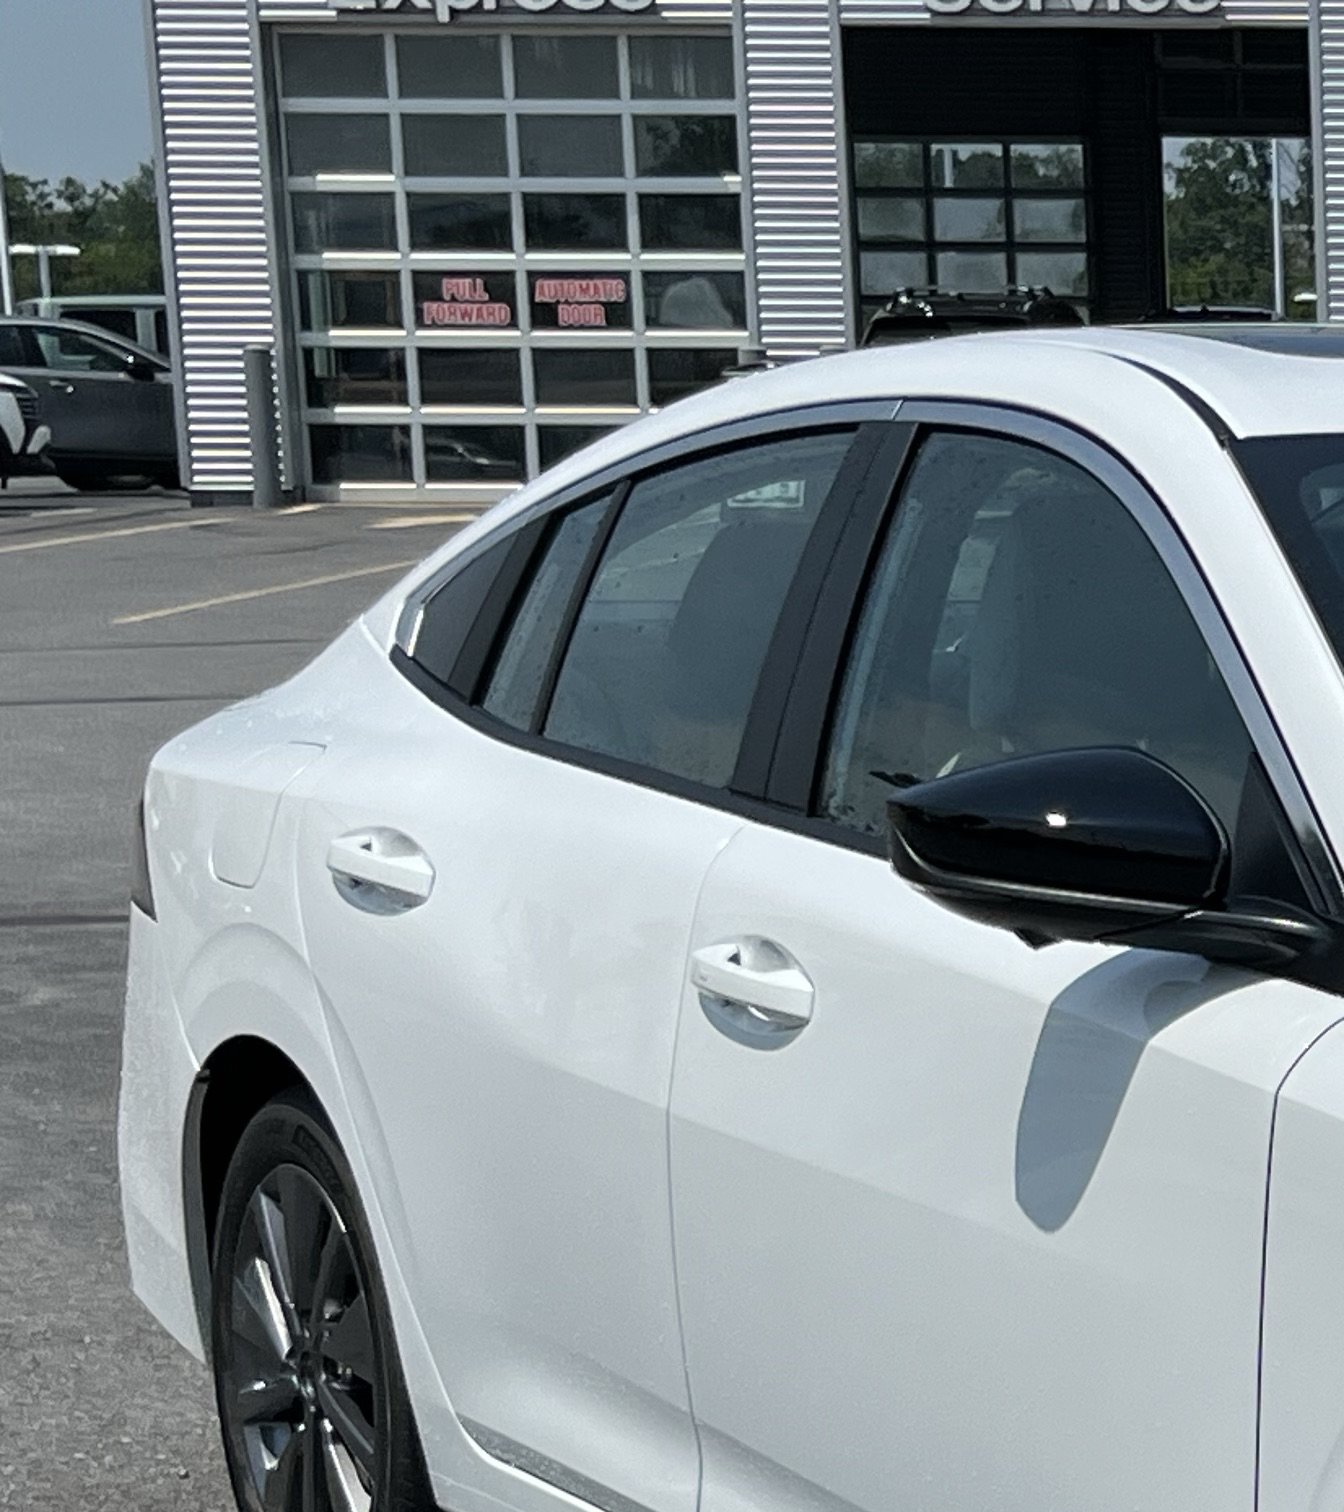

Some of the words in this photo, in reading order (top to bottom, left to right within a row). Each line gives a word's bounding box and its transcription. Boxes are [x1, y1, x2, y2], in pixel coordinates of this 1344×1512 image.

[442, 278, 489, 301] PULL
[534, 279, 625, 303] AUTOMATIC
[423, 302, 511, 325] FORWARD
[558, 304, 606, 326] DOOR
